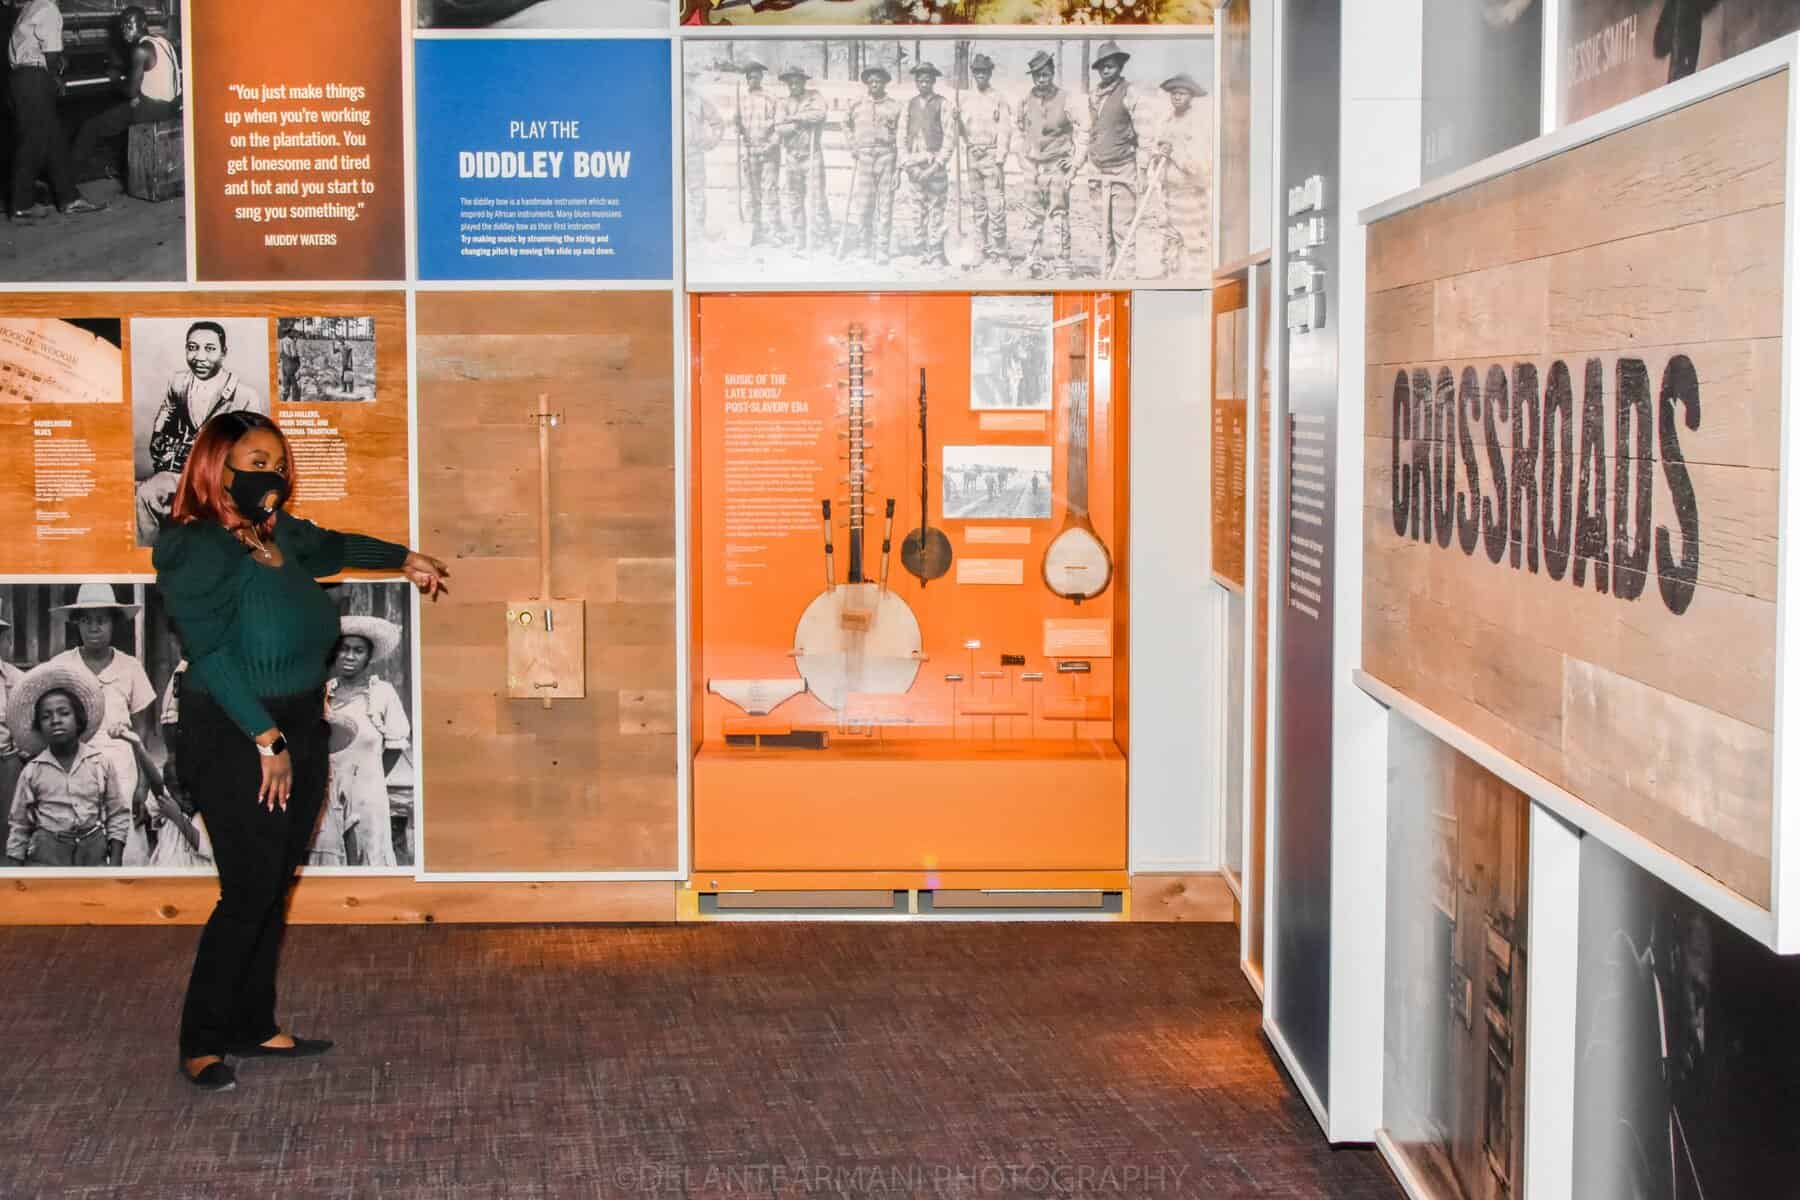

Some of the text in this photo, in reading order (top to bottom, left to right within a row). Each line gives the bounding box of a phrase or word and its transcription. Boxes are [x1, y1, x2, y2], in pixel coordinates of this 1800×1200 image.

[1602, 13, 1637, 73] SMITH
[228, 83, 365, 102] “You just make things
[224, 111, 241, 127] up
[244, 108, 277, 124] when
[321, 108, 371, 126] working
[509, 120, 580, 139] PLAY THE
[230, 131, 367, 151] on the plantation. You
[227, 154, 370, 176] get lonesome and tired
[459, 151, 631, 179] DIDDLEY BOW
[224, 179, 375, 198] and hot and you start to
[235, 205, 262, 222] sing
[264, 206, 287, 222] you
[264, 233, 337, 247] MUDDY WATERS
[1392, 355, 1700, 615] CROSSROADS
